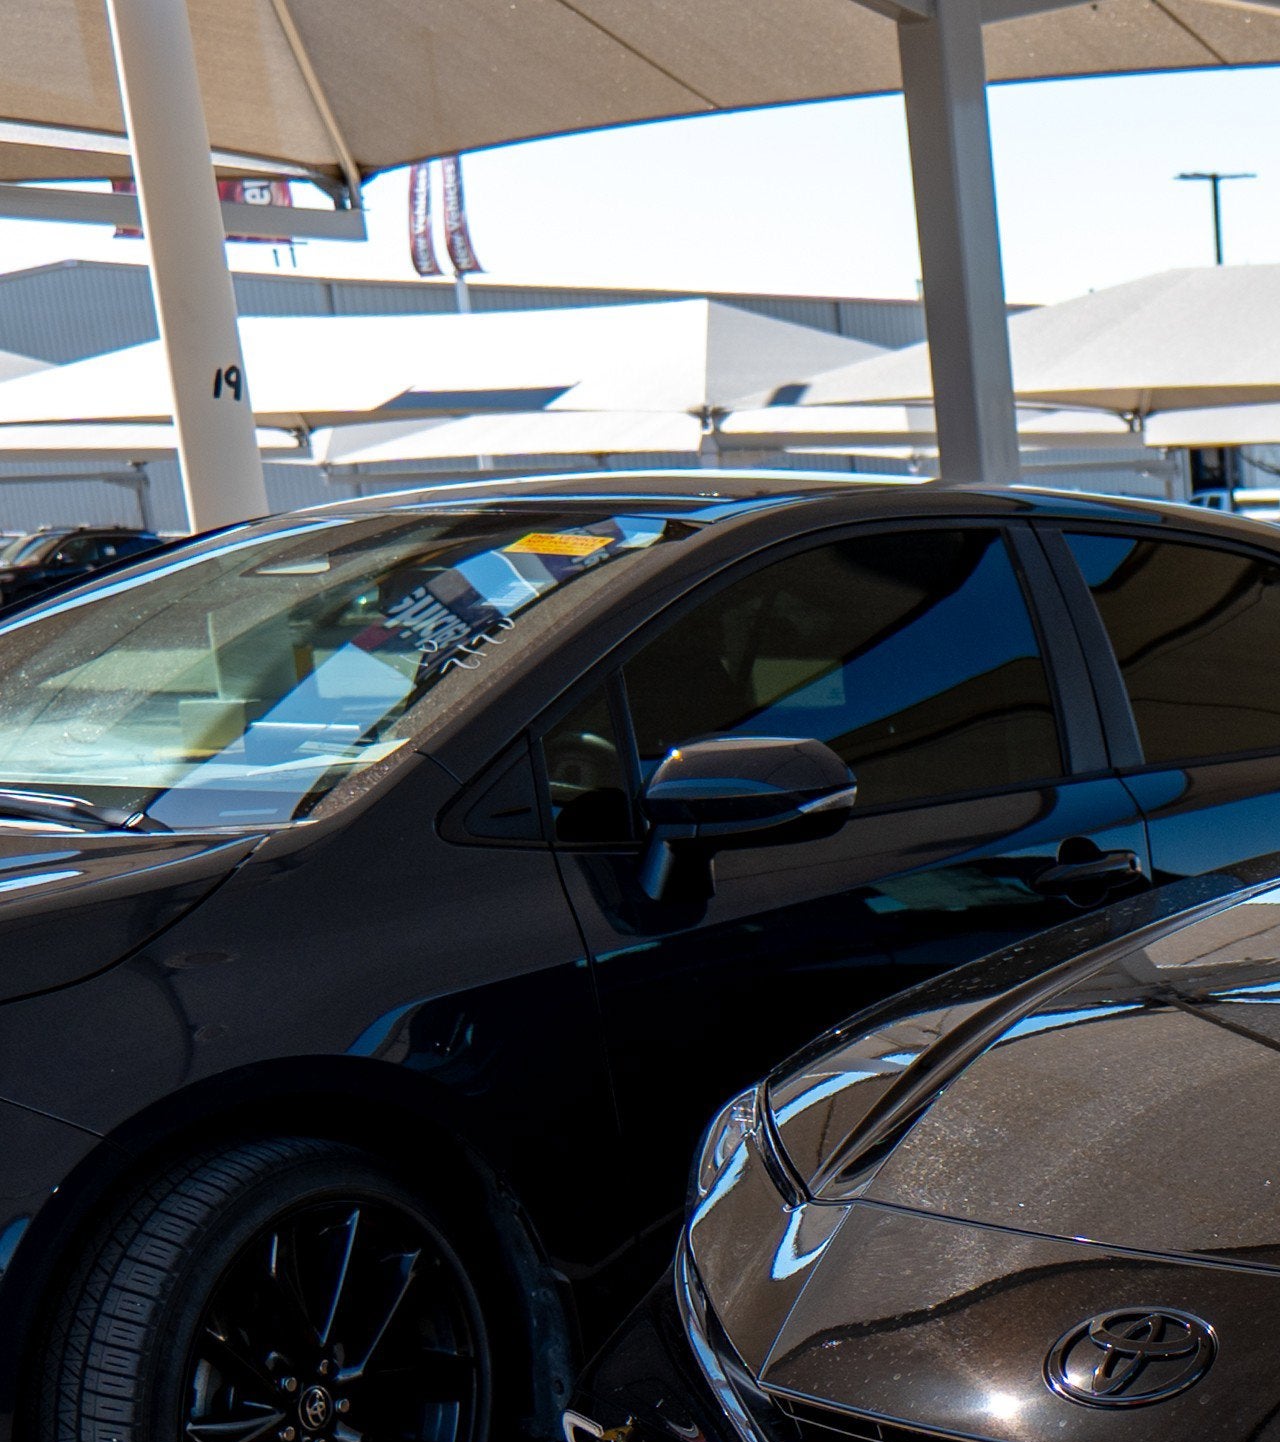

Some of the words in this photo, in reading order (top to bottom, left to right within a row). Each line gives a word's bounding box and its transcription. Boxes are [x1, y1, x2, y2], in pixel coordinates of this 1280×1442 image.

[445, 163, 459, 230] Vehicles
[453, 232, 472, 270] New
[213, 365, 242, 401] 19
